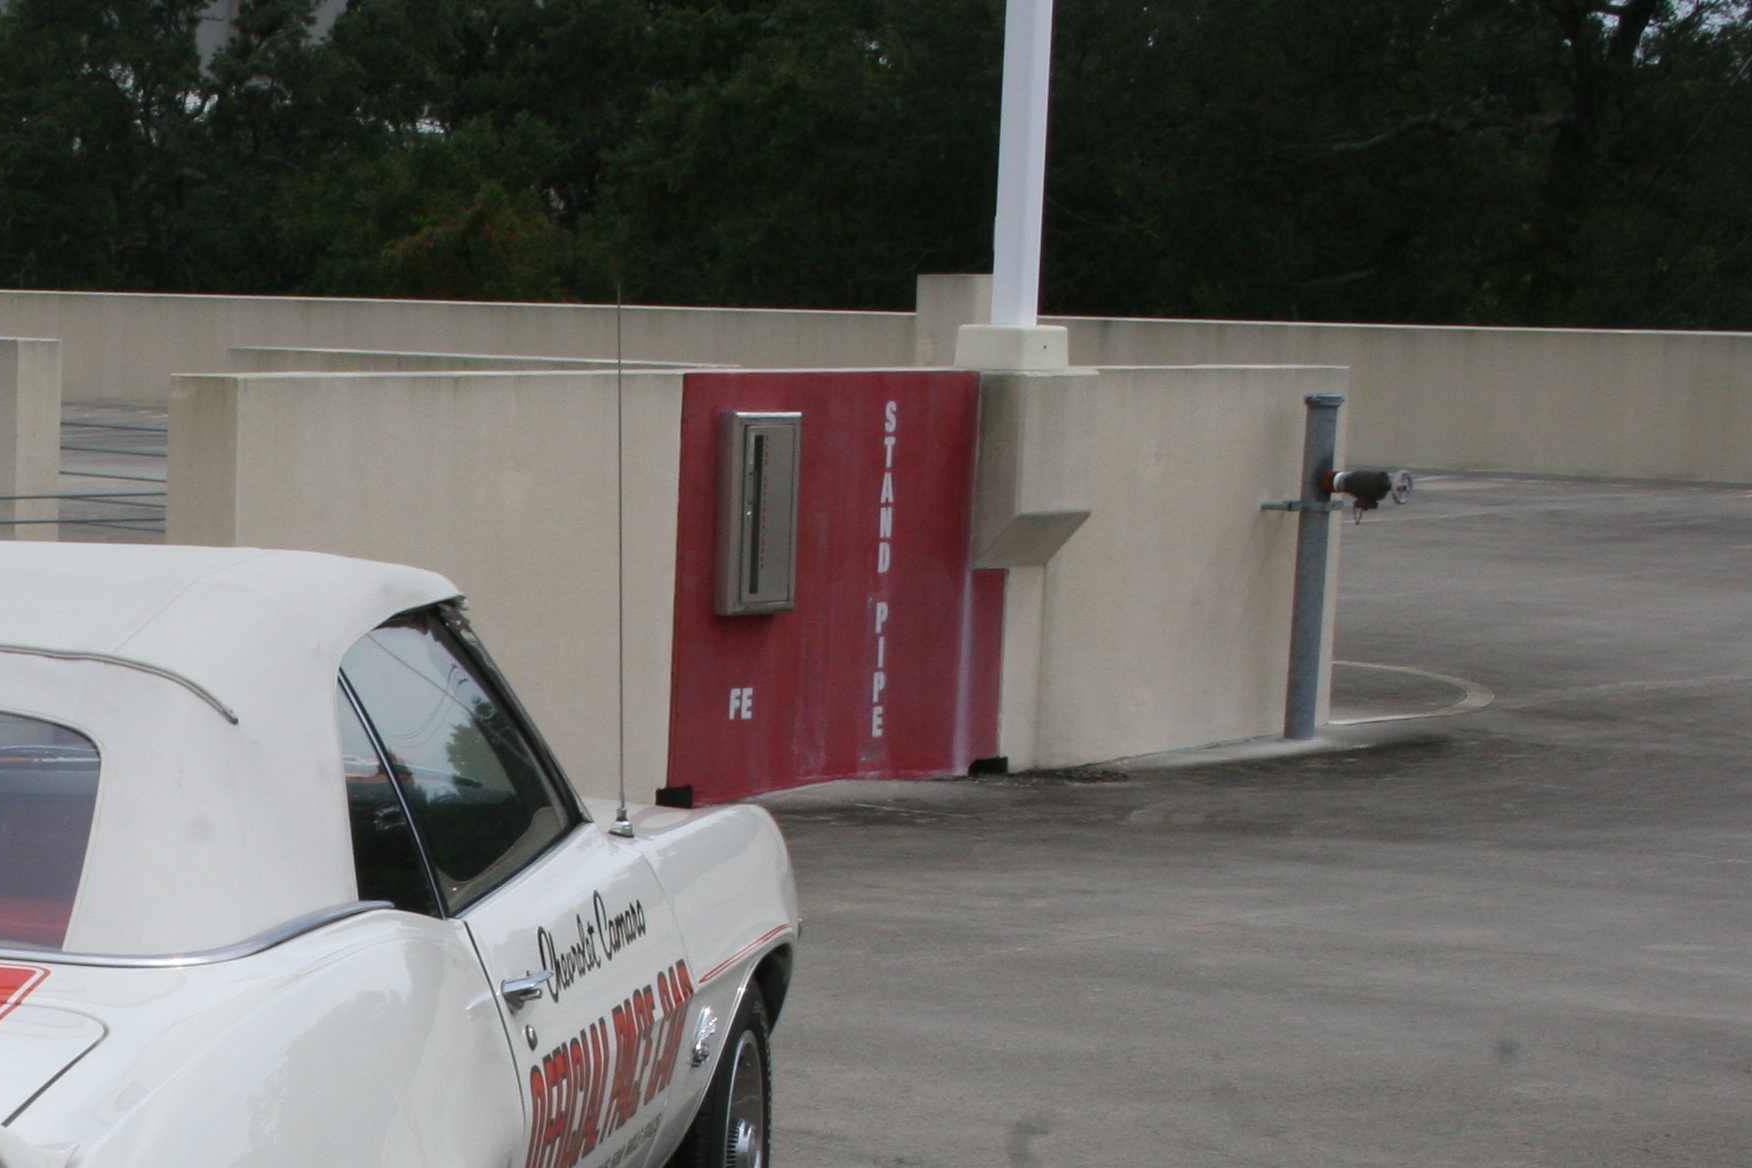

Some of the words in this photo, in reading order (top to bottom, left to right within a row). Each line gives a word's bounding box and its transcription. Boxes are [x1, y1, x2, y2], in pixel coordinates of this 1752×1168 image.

[877, 401, 897, 573] STAND
[728, 687, 754, 720] FE
[871, 602, 889, 738] PIPE
[537, 926, 602, 1004] Chevrolet
[592, 889, 646, 962] Camaro
